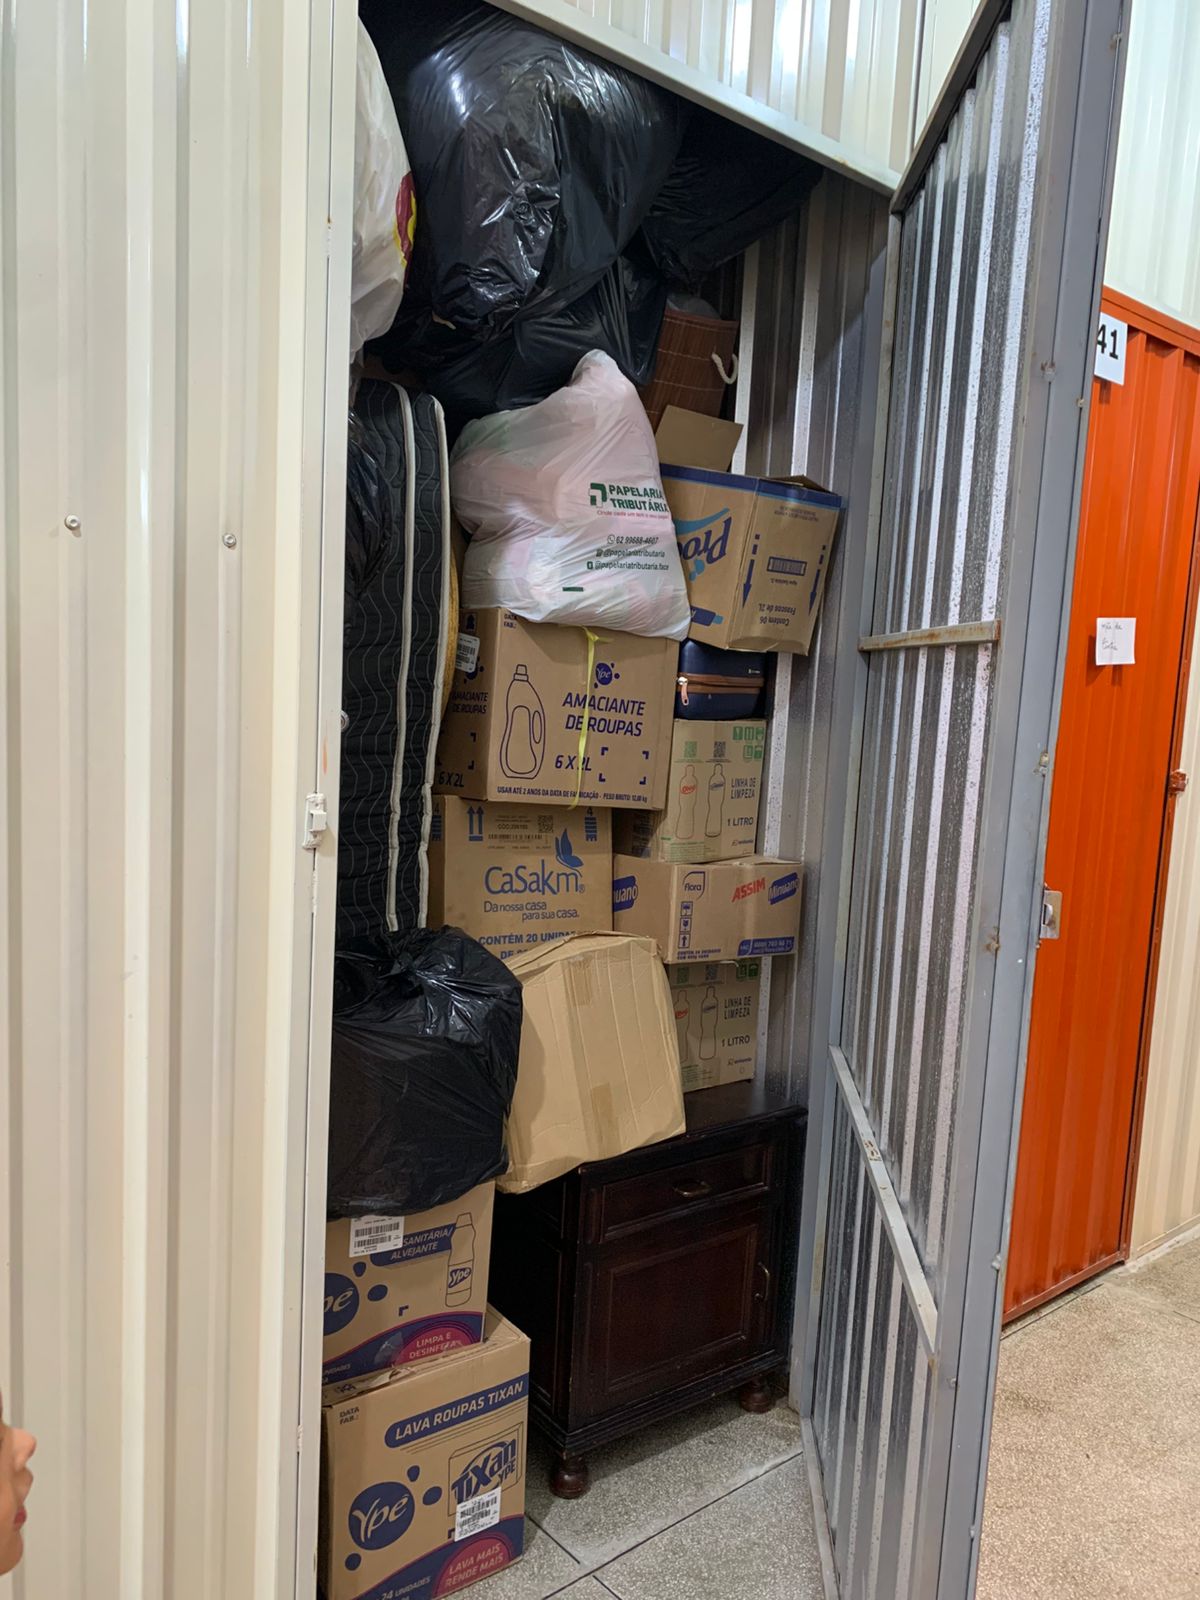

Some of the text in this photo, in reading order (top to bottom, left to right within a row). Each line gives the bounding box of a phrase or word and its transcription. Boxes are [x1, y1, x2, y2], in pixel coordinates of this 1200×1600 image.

[1097, 324, 1119, 360] 41
[608, 484, 664, 500] PAPELARIA
[610, 498, 669, 512] TRIBUTÁRIA
[616, 536, 624, 544] 62
[452, 691, 489, 703] AMACIANTE
[562, 692, 646, 717] AMACIANTE
[462, 704, 487, 715] ROUPAS
[565, 714, 643, 737] DE ROUPAS
[555, 755, 564, 769] 6
[565, 755, 577, 770] X
[438, 771, 465, 788] 6 X 2L
[731, 778, 748, 788] LINHA
[749, 777, 756, 787] DE
[497, 786, 513, 794] USAR
[527, 788, 541, 796] ANOS
[550, 789, 562, 797] DATA
[731, 788, 755, 799] LIMPEZA
[733, 817, 754, 827] LITRO
[731, 877, 766, 903] ASSIM
[484, 900, 547, 913] Da nossa casa
[522, 908, 580, 923] para sua casa.
[479, 931, 524, 946] CONTÉM
[526, 933, 538, 943] 20
[724, 996, 752, 1009] LINHA DE
[724, 1007, 751, 1020] LIMPEZA
[727, 1035, 750, 1047] LITRO
[391, 1241, 439, 1260] ALVEJANTE
[416, 1332, 452, 1349] LIMPA E
[395, 1380, 524, 1440] LAVA ROUPAS TIXAN
[449, 1544, 502, 1576] LAVA MAIS
[445, 1553, 504, 1587] RENDE MAIS
